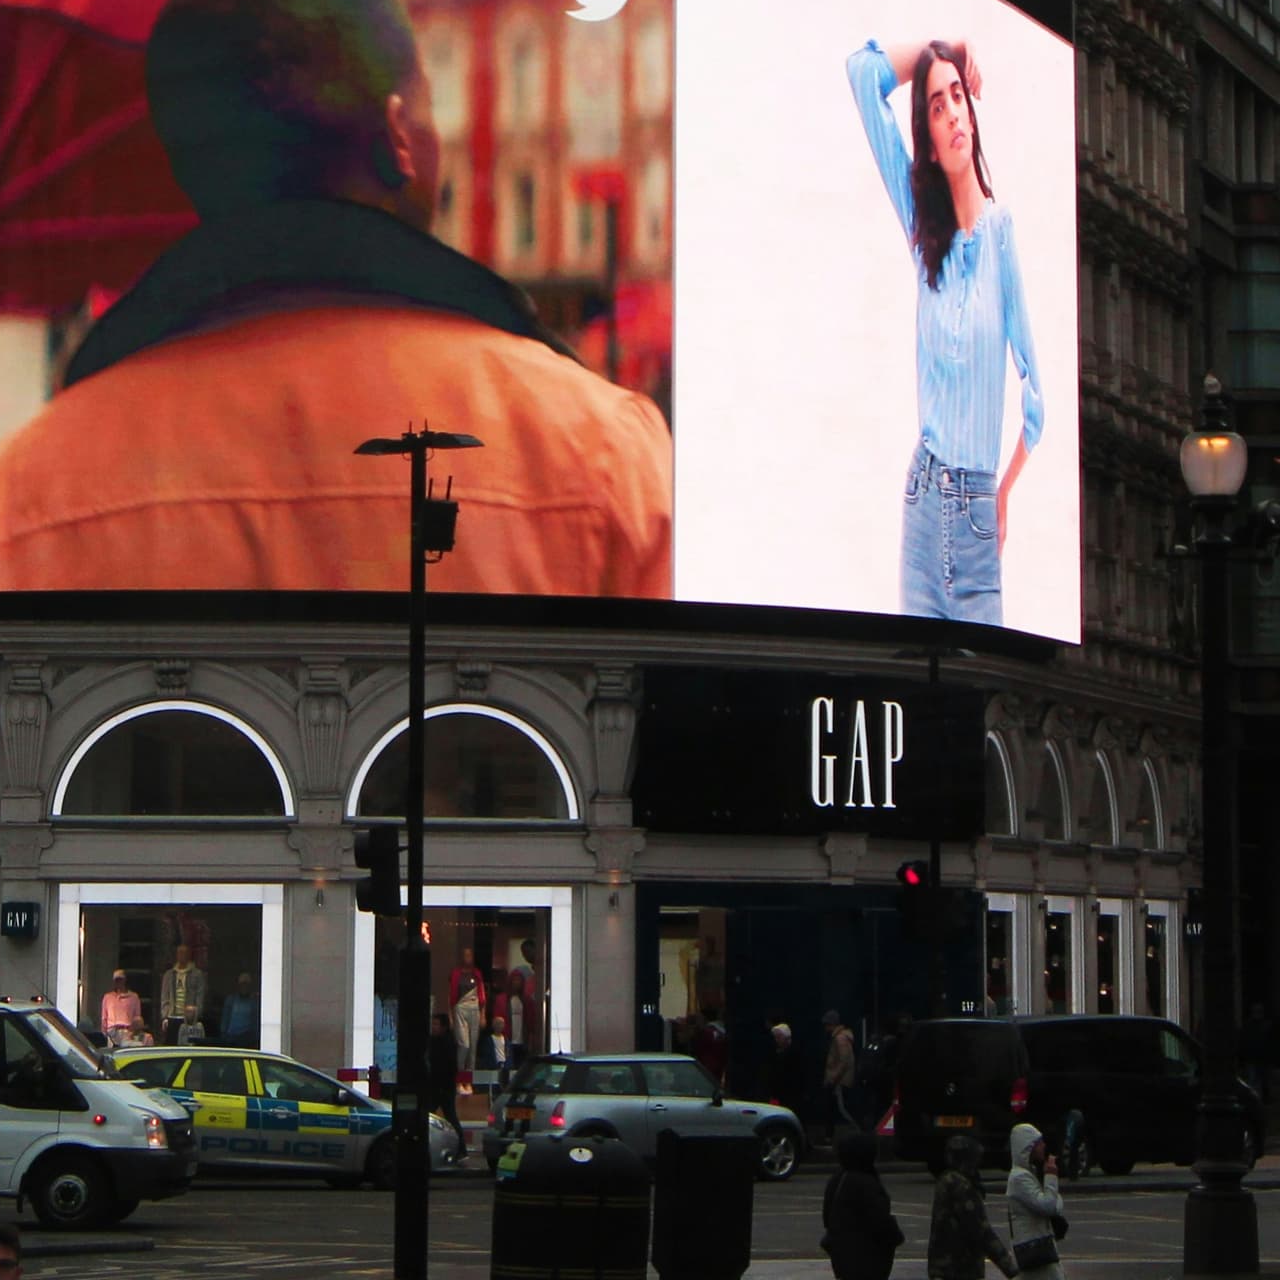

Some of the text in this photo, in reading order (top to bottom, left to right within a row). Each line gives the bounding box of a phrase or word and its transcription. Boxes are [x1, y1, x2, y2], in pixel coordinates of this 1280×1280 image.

[810, 696, 905, 809] GAP
[7, 911, 28, 928] GAP
[1186, 922, 1203, 935] GAP
[201, 1135, 347, 1159] POLICE
